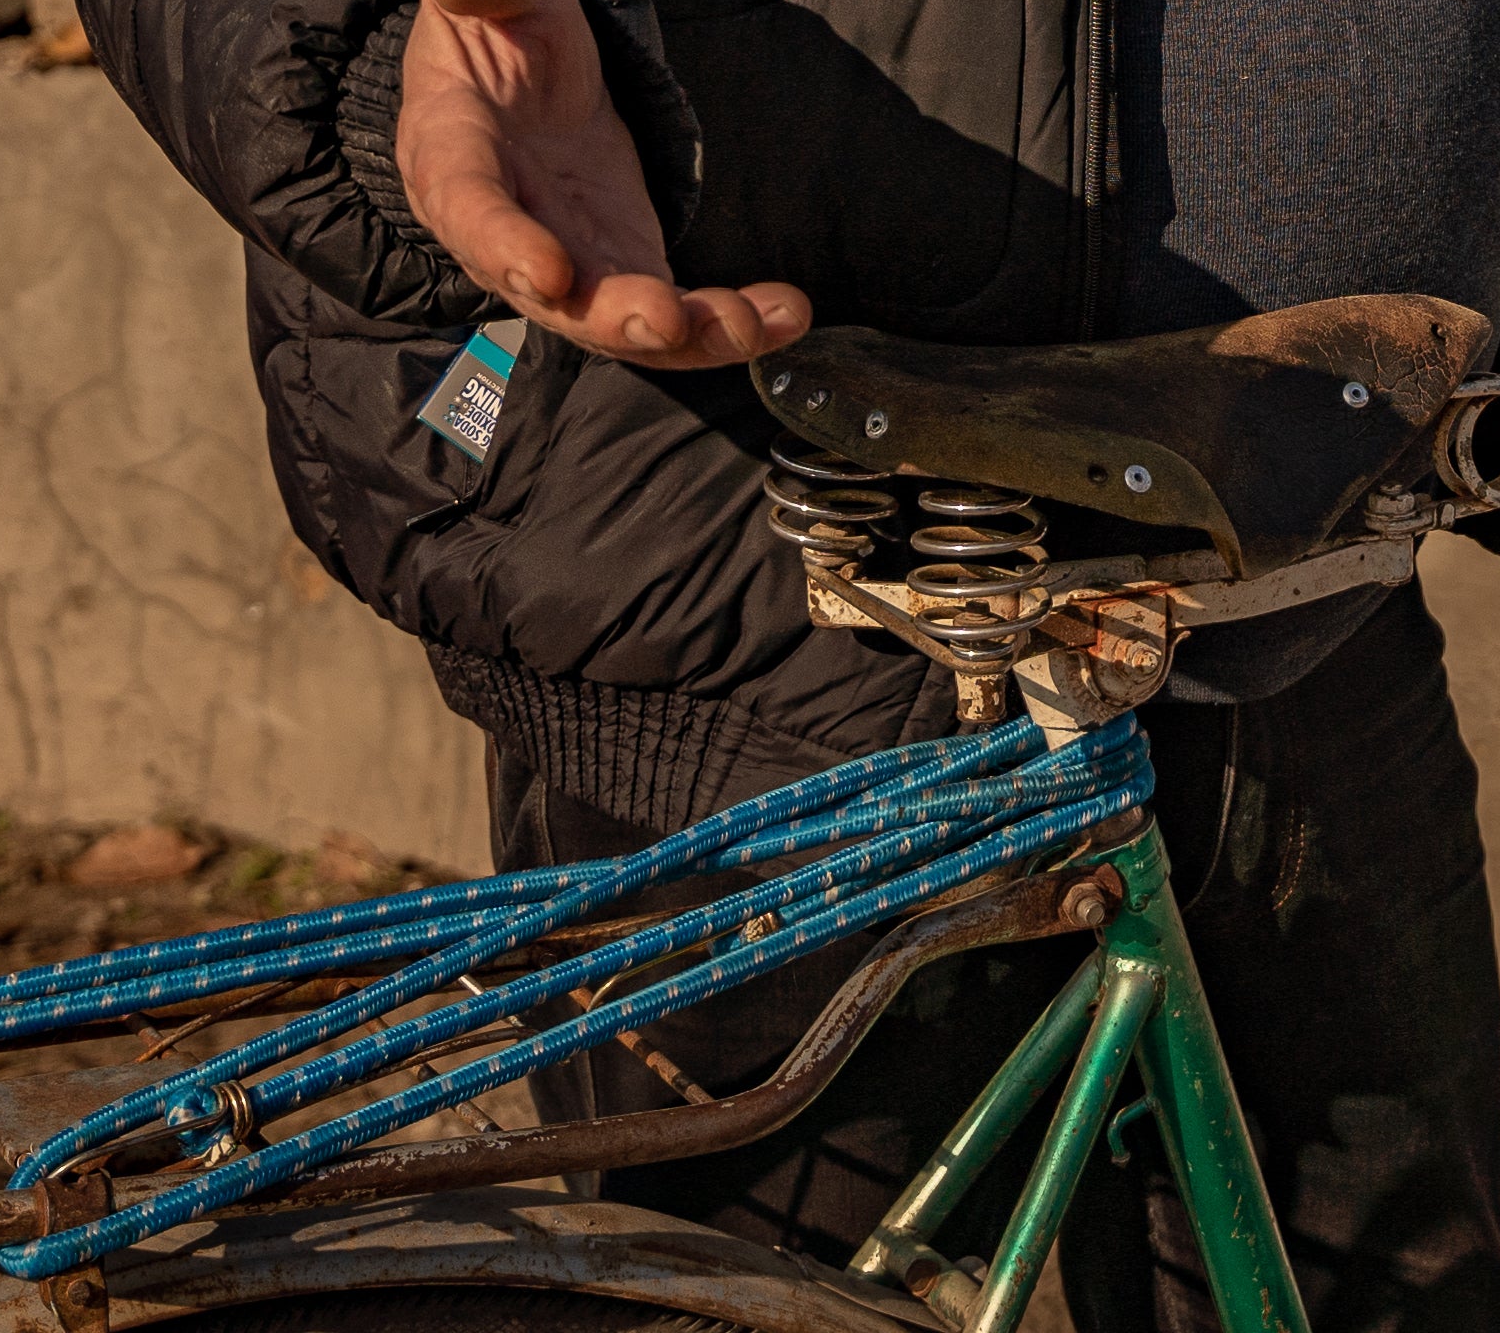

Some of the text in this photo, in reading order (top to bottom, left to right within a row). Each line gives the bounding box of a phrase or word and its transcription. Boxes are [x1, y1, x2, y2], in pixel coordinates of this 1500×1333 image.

[461, 377, 503, 419] NING
[476, 372, 505, 396] TECTION
[453, 414, 483, 442] SODA
